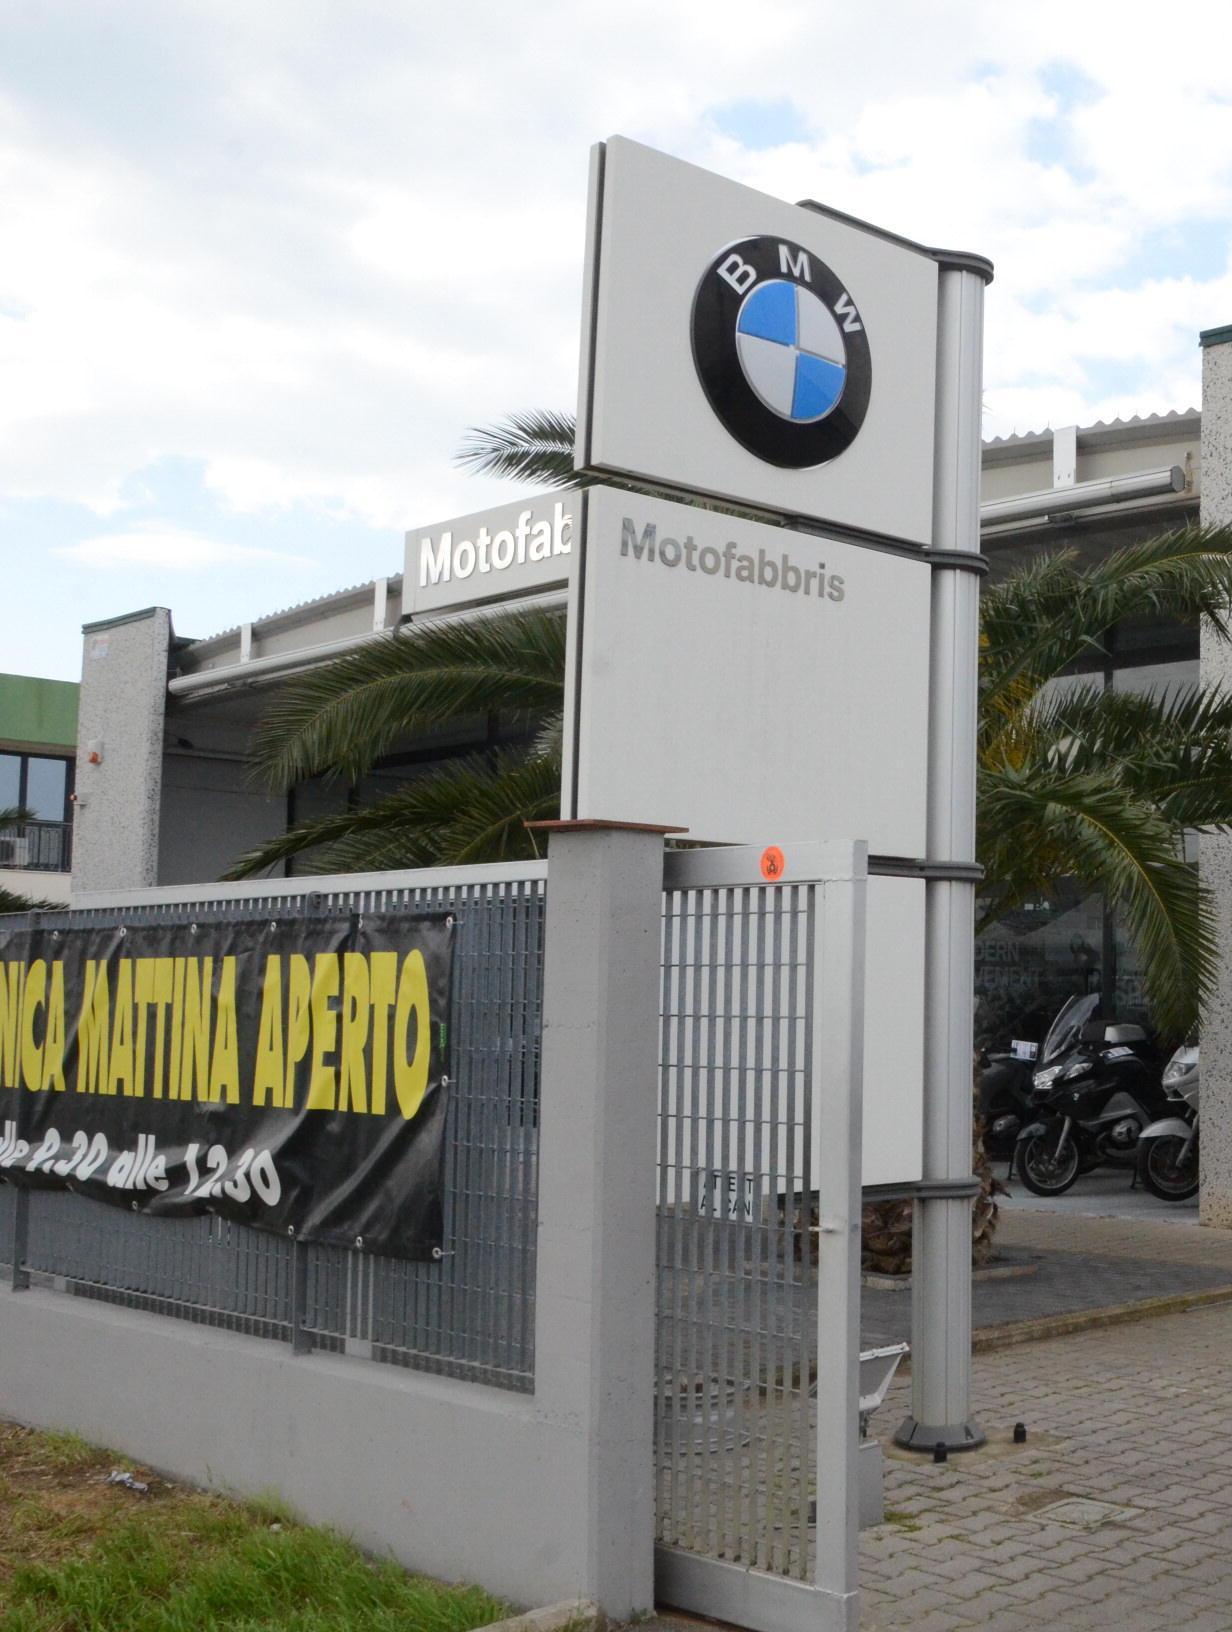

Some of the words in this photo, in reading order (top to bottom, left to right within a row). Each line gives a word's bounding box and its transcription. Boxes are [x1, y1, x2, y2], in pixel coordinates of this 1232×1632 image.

[716, 244, 862, 333] BMW
[418, 501, 573, 588] Motofab
[619, 516, 846, 602] Motofabbris
[76, 955, 240, 1105] MATTINA
[252, 948, 431, 1120] APERTO
[0, 1120, 30, 1168] lle
[106, 1133, 170, 1192] alle
[183, 1143, 282, 1207] 12.30
